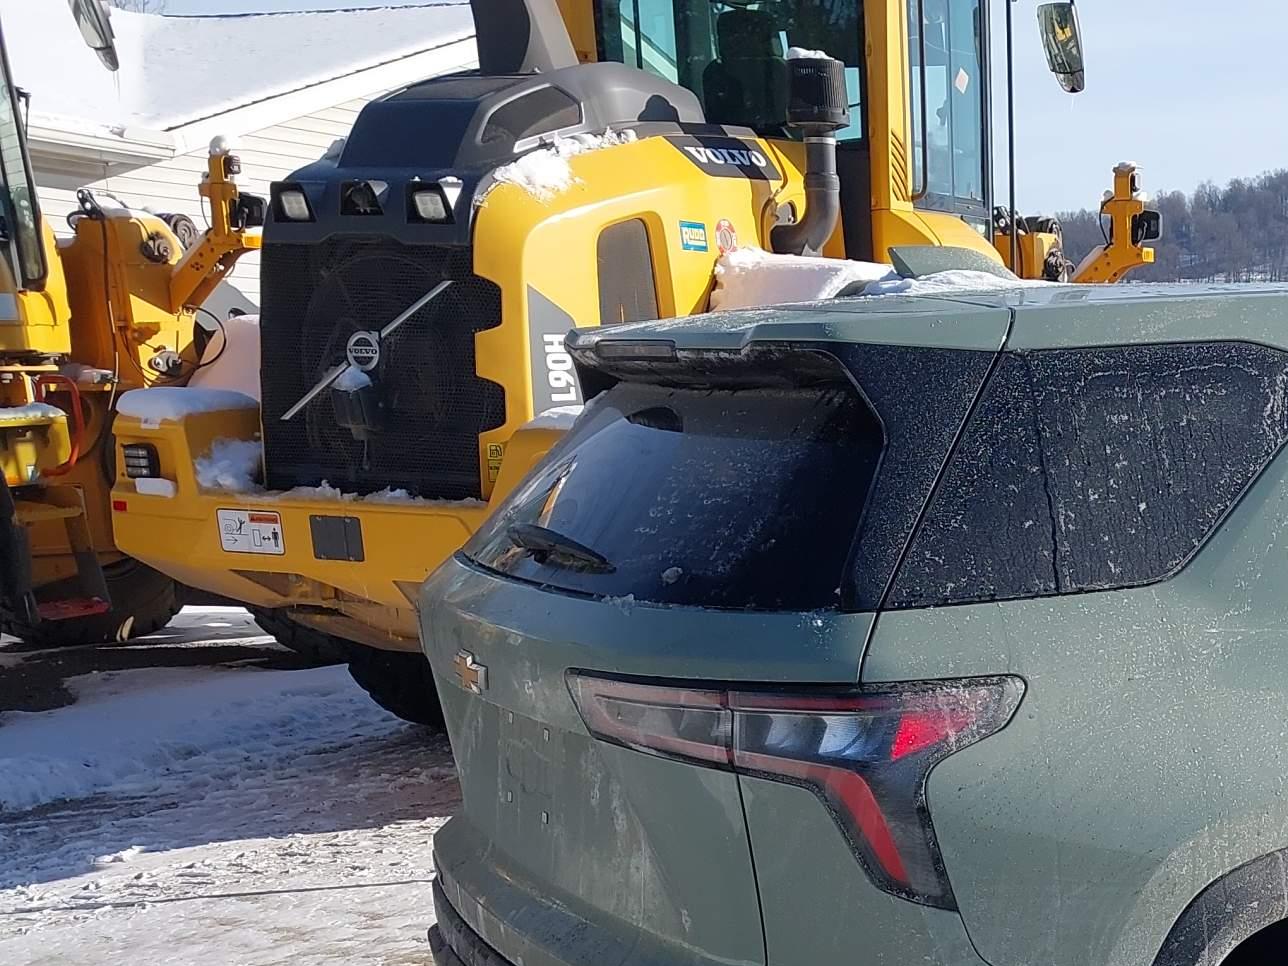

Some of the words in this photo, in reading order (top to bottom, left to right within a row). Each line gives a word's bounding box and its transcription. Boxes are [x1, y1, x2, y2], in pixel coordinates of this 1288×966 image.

[683, 146, 767, 167] VOLVO
[348, 347, 378, 356] VOLVO
[542, 333, 577, 402] L90H
